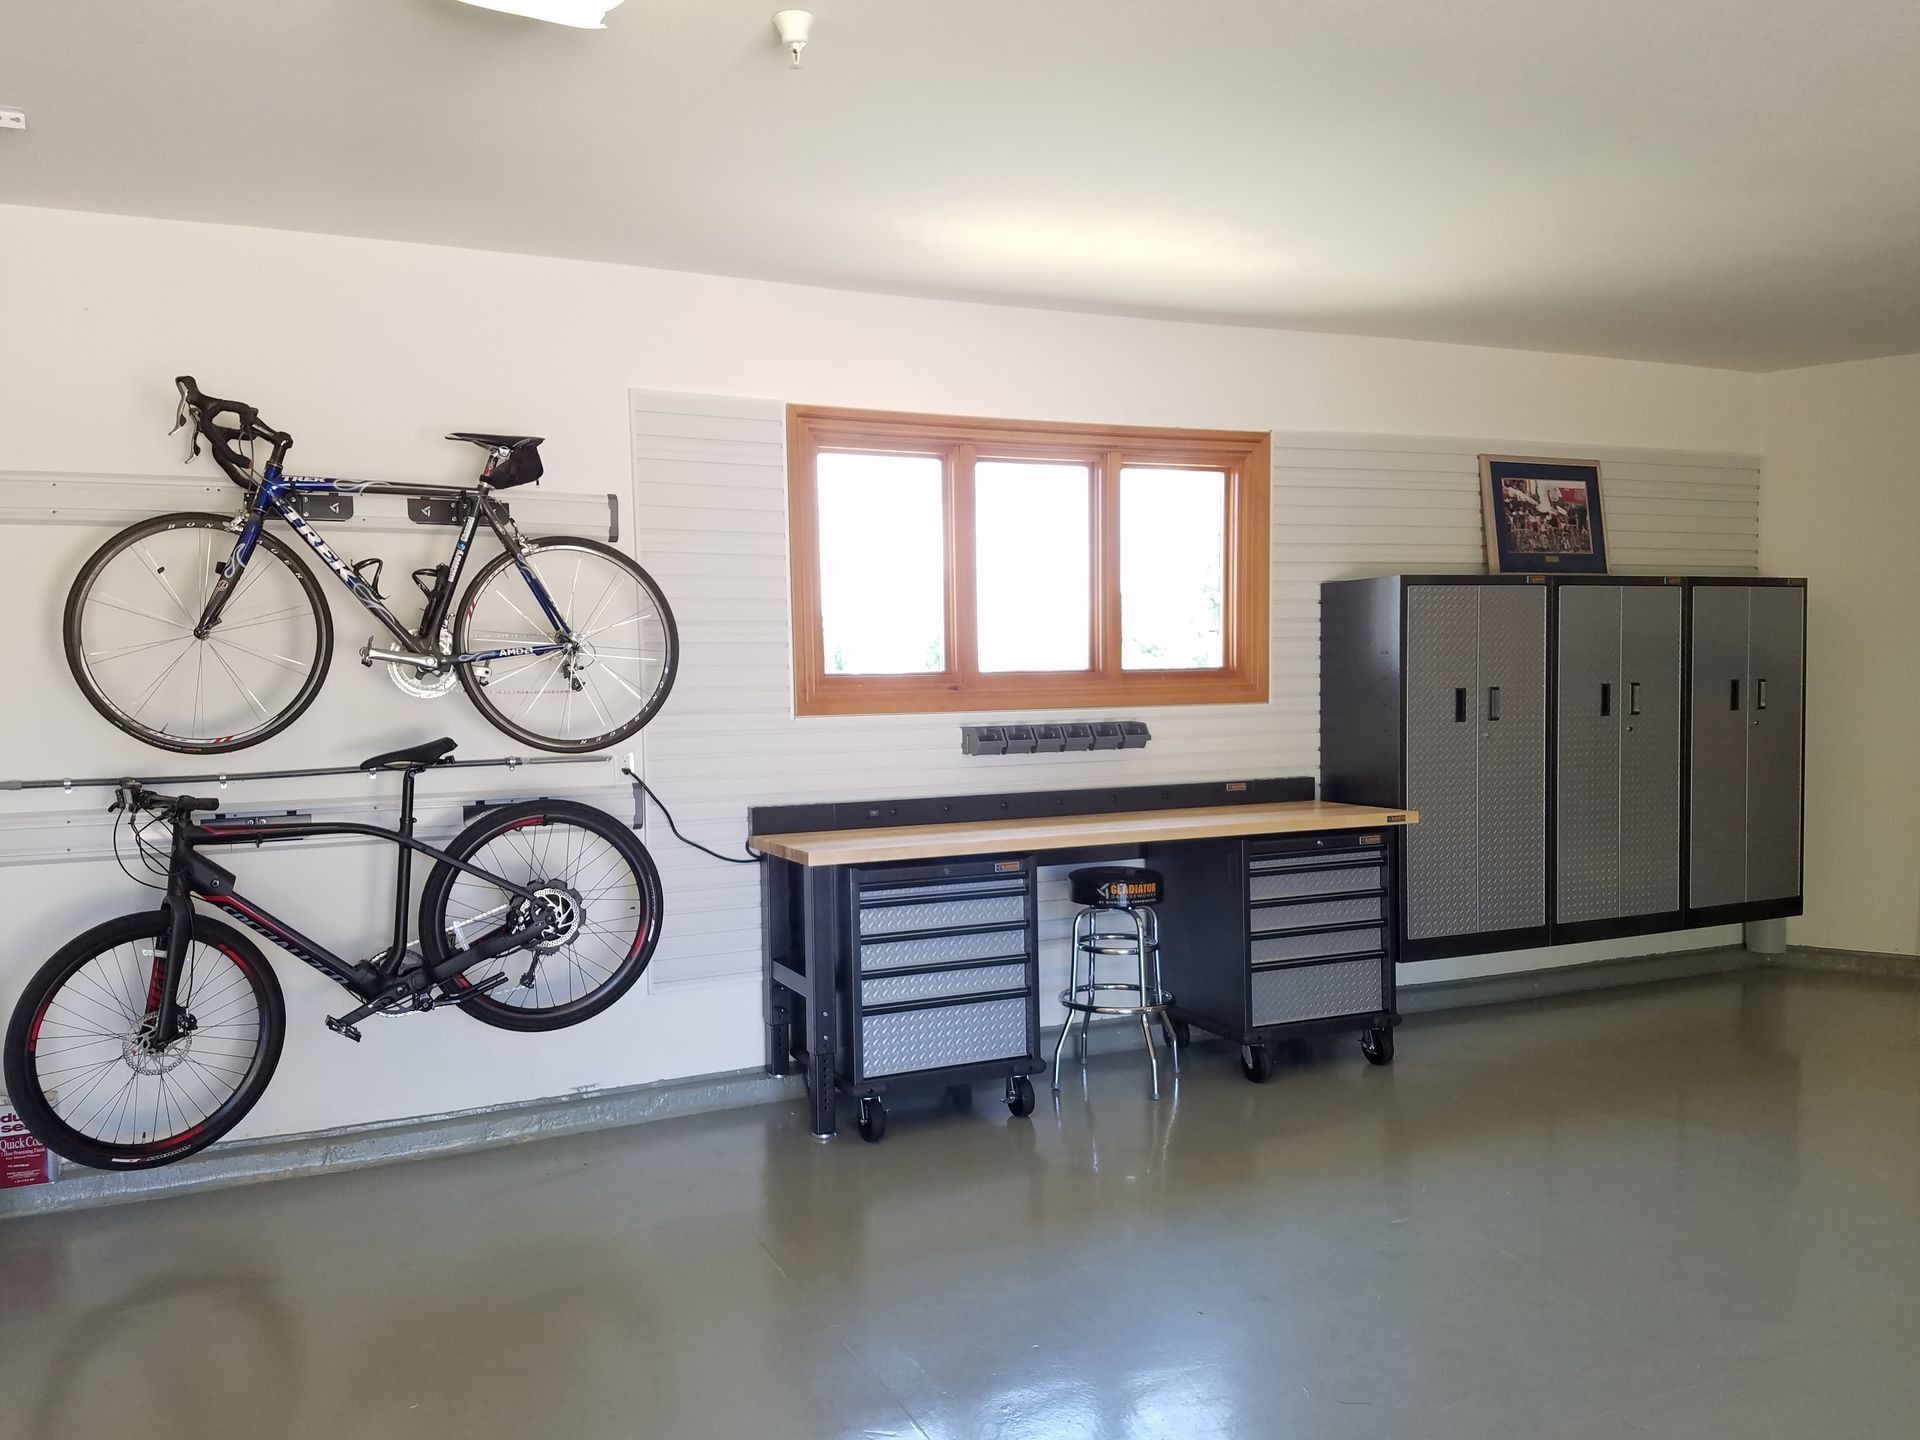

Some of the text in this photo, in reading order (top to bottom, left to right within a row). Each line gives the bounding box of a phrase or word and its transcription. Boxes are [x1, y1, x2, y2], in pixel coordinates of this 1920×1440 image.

[277, 500, 358, 583] TREK
[167, 522, 304, 580] BONAGER
[1110, 883, 1156, 895] GLADIATOR
[0, 1113, 21, 1123] du
[0, 1136, 43, 1152] Quick Co
